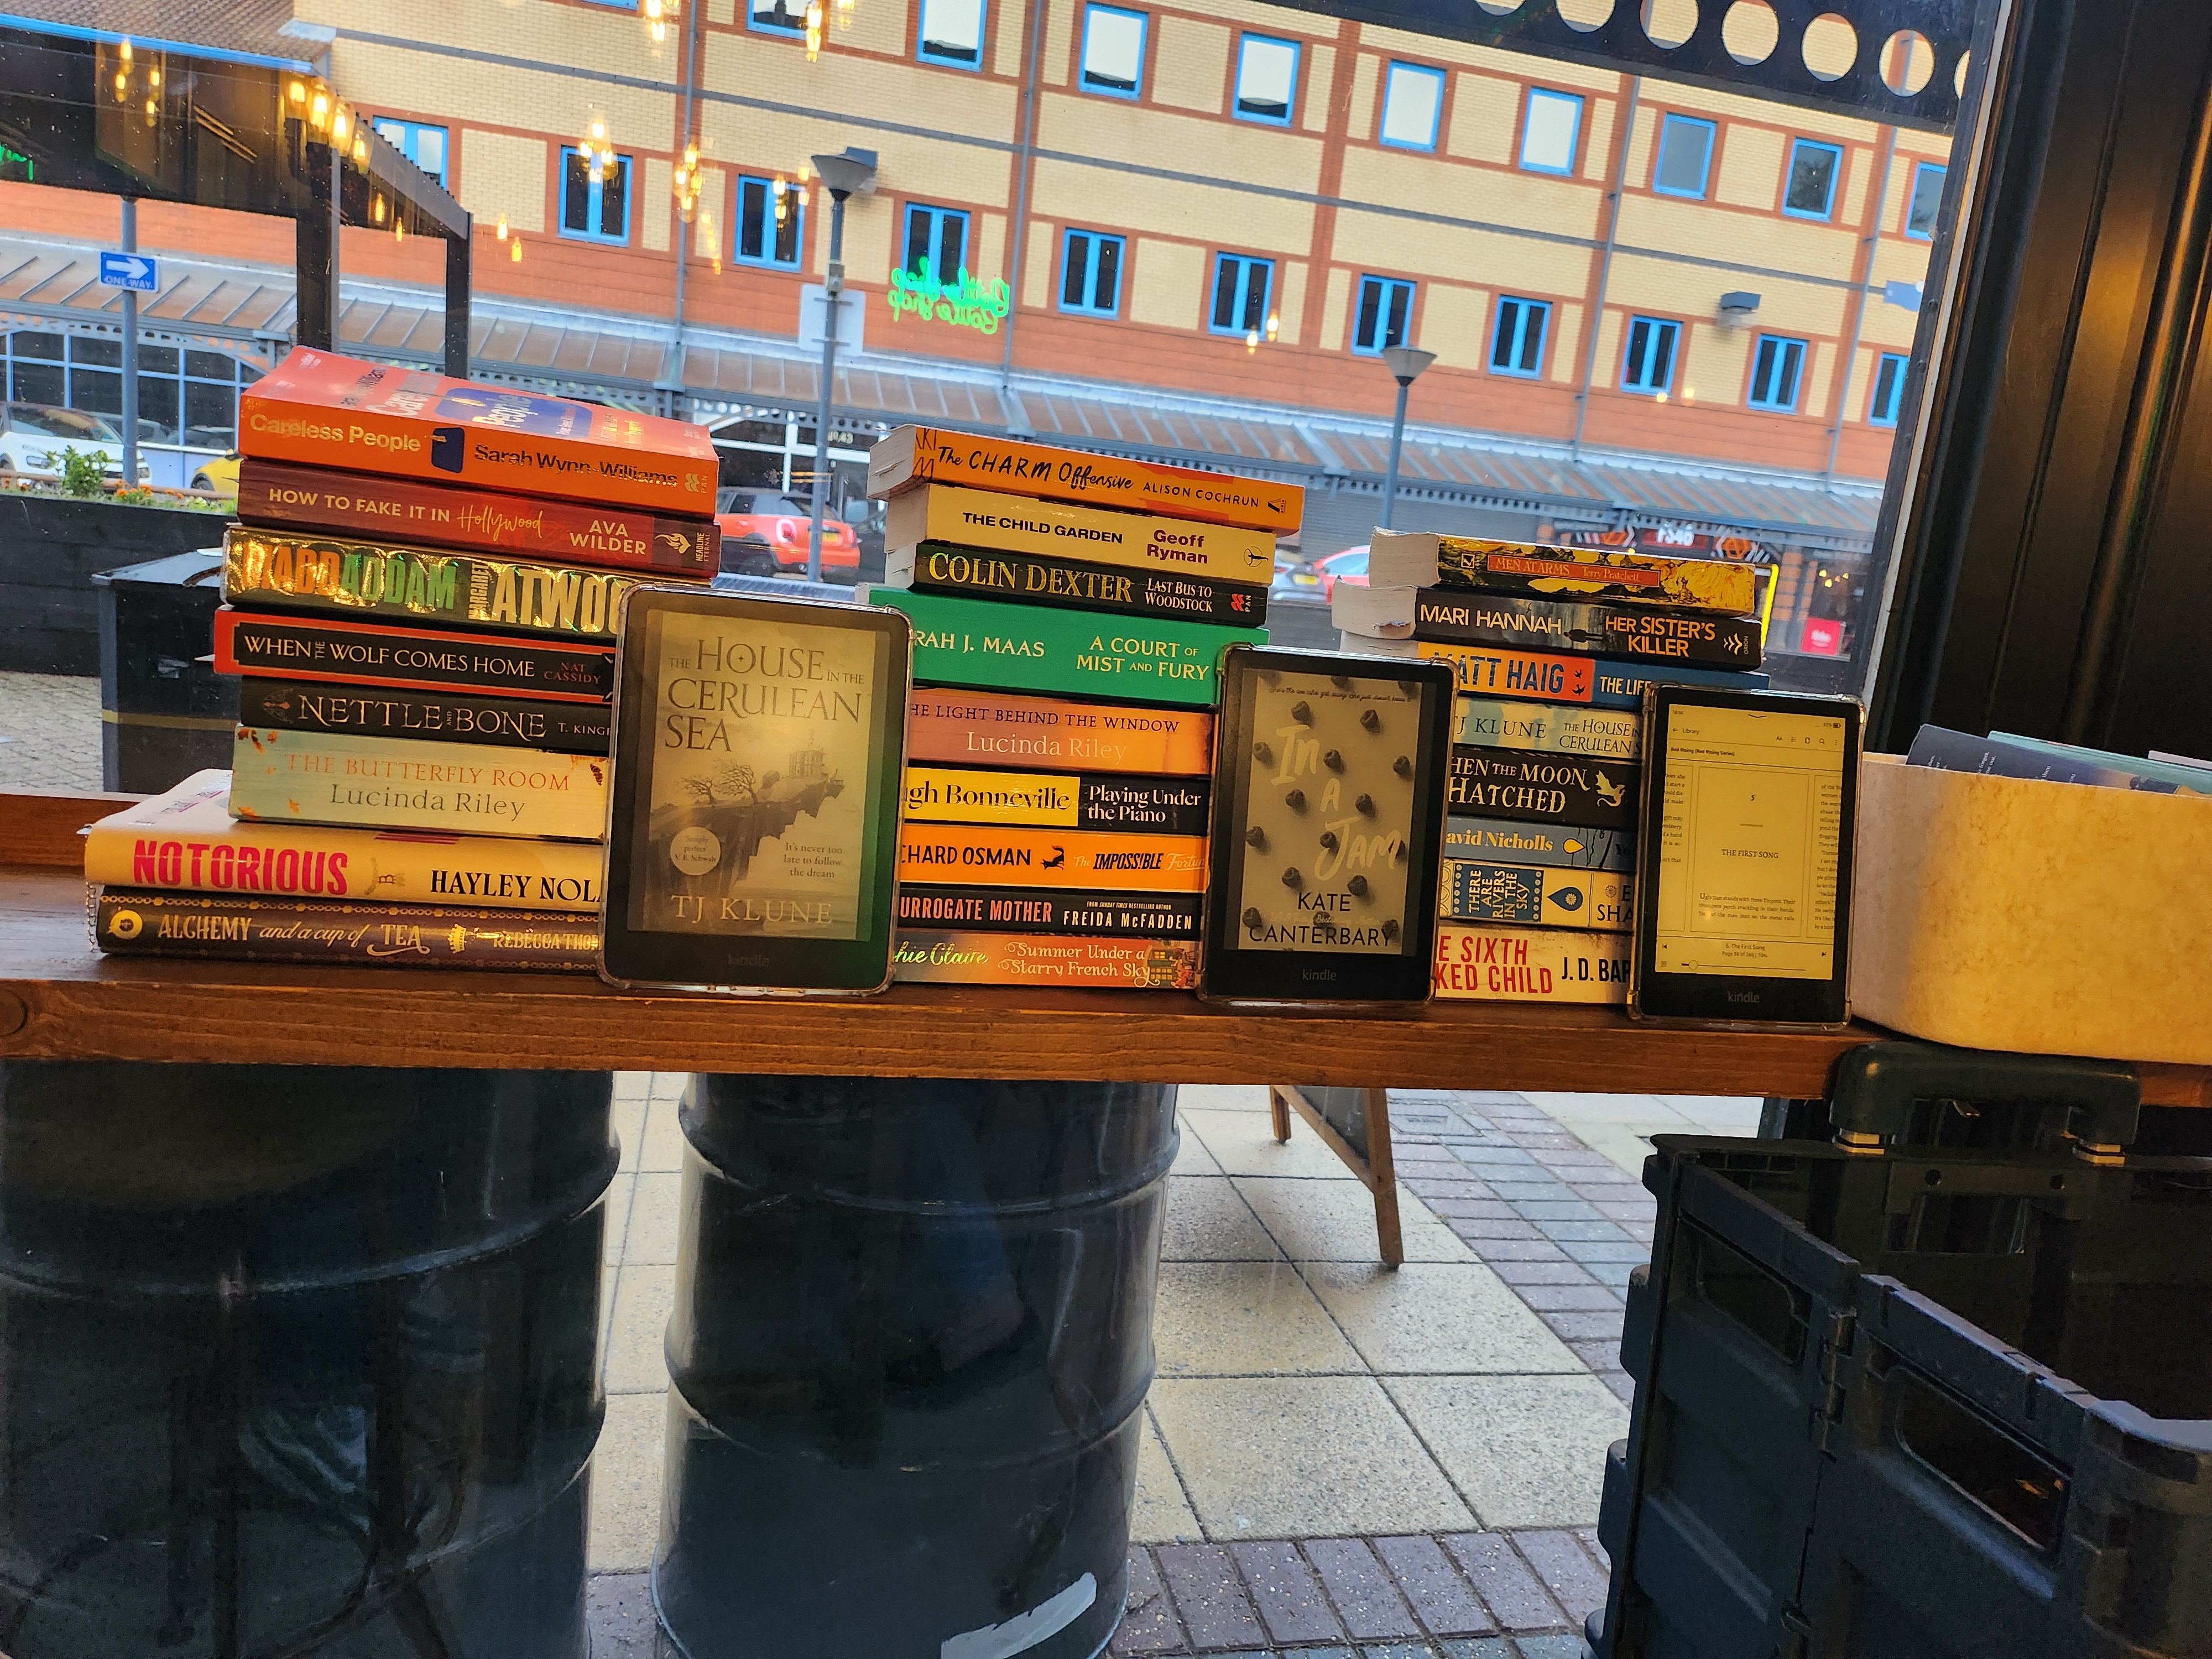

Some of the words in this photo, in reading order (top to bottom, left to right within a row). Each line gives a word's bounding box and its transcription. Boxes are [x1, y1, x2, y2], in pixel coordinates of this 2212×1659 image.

[250, 414, 344, 442] Careless
[348, 425, 421, 453] People
[474, 444, 532, 467] Sarah
[536, 452, 678, 487] Wynn-Williams
[938, 446, 964, 466] The
[969, 450, 1053, 482] CHARM
[1058, 461, 1134, 491] Offensive
[1142, 482, 1191, 498] ALISON
[1195, 489, 1259, 508] COCHRUN
[269, 488, 318, 506] HOW
[324, 494, 350, 510] TO
[356, 499, 401, 517] FAKE
[409, 505, 426, 519] IT
[431, 508, 450, 523] IN
[457, 504, 543, 541] Hollywood
[588, 519, 629, 538] AVA
[962, 512, 996, 528] THE
[998, 517, 1051, 535] CHILD
[1053, 525, 1123, 544] GARDEN
[1153, 529, 1205, 548] Geoff
[569, 531, 646, 555] WILDER
[695, 531, 705, 562] HEADLINE
[1146, 543, 1209, 565] Ryman
[928, 551, 1016, 589] COLIN
[1025, 563, 1134, 604] DEXTER
[1495, 557, 1522, 570] MEN
[1522, 560, 1537, 572] AT
[1537, 562, 1571, 576] ARMS
[468, 562, 490, 620] MARGARET
[1147, 577, 1174, 593] LAST
[1144, 591, 1213, 613] WOODSTOCK
[1244, 593, 1252, 613] PAN
[1420, 604, 1468, 626] MARI
[1476, 609, 1562, 635] HANNAH
[1605, 615, 1637, 633] HER
[1640, 616, 1717, 641] SISTER'S
[244, 635, 311, 658] WHEN
[315, 640, 326, 660] THE
[330, 643, 390, 665] WOLF
[394, 649, 468, 672] COMES
[474, 656, 535, 677] HOME
[962, 634, 975, 654] J.
[983, 637, 1045, 658] MAAS
[1089, 635, 1104, 652] A
[1110, 638, 1180, 658] COURT
[1184, 646, 1199, 657] OF
[1627, 634, 1690, 658] KILLER
[560, 662, 586, 673] NAT
[669, 657, 691, 669] THE
[696, 636, 825, 681] HOUSE
[827, 669, 840, 682] IN
[842, 672, 864, 684] THE
[1076, 654, 1126, 674] MIST
[1129, 662, 1153, 673] AND
[1157, 661, 1210, 681] FURY
[544, 671, 602, 684] CASSIDY
[1506, 659, 1564, 693] HAIG
[1600, 676, 1624, 695] THE
[667, 677, 862, 723] CERULEAN
[299, 694, 444, 731] NETTLE
[453, 707, 547, 742] BONE
[557, 722, 568, 734] T.
[936, 705, 990, 721] LIGHT
[995, 709, 1059, 726] BEHIND
[1065, 714, 1098, 728] THE
[1102, 717, 1181, 734] WINDOW
[1475, 718, 1547, 739] KLUNE
[1564, 723, 1579, 732] THE
[1582, 718, 1631, 737] HOUSE
[665, 714, 732, 752] SEA
[1559, 735, 1632, 754] CERULEAN
[966, 731, 1062, 757] Lucinda
[1068, 737, 1128, 765] Riley
[1270, 724, 1321, 786] In
[287, 754, 334, 774] THE
[346, 758, 484, 785] BUTTERFLY
[492, 769, 570, 791] ROOM
[1493, 763, 1517, 776] THE
[1519, 764, 1591, 791] MOON
[330, 784, 444, 811] Lucinda
[454, 791, 526, 821] Riley
[946, 783, 1071, 810] Bonneville
[1089, 785, 1148, 807] Playing
[1152, 789, 1202, 807] Under
[1447, 776, 1566, 813] HATCHED
[1087, 805, 1115, 822] the
[1119, 807, 1166, 823] Piano
[785, 842, 798, 852] It's
[801, 845, 826, 853] never
[1485, 832, 1553, 852] Nicholls
[1758, 851, 1779, 859] SONG
[133, 839, 348, 895] NOTORIOUS
[784, 853, 800, 864] late
[815, 855, 843, 866] follow
[962, 847, 1031, 867] OSMAN
[1074, 855, 1092, 868] The
[430, 869, 533, 899] HAYLEY
[790, 867, 805, 877] the
[807, 868, 834, 878] dream
[1468, 869, 1482, 914] THERE
[1481, 878, 1493, 907] ARE
[1492, 870, 1506, 919] RIVERS
[1505, 872, 1517, 900] THE
[1516, 882, 1530, 910] SKY
[671, 894, 706, 924] TJ
[720, 897, 833, 925] KLUNE
[989, 899, 1053, 924] MOTHER
[1297, 893, 1352, 912] KATE
[1504, 901, 1516, 919] IN
[1063, 910, 1113, 928] FREIDA
[158, 914, 252, 941] ALCHEMY
[259, 921, 302, 939] and
[369, 924, 428, 954] TEA
[1249, 924, 1392, 947] CANTERBARY
[728, 953, 770, 968] kindle
[1006, 941, 1083, 961] Summer
[1087, 944, 1130, 961] Under
[1135, 950, 1145, 961] a
[1460, 936, 1528, 965] SIXTH
[1000, 959, 1064, 978] Starry
[1067, 961, 1119, 978] French
[1123, 963, 1160, 988] Sky
[1302, 969, 1337, 981] kindle
[1488, 966, 1553, 994] CHILD
[1561, 957, 1573, 981] J.
[1578, 957, 1594, 982] D.
[1727, 991, 1760, 1003] kindle
